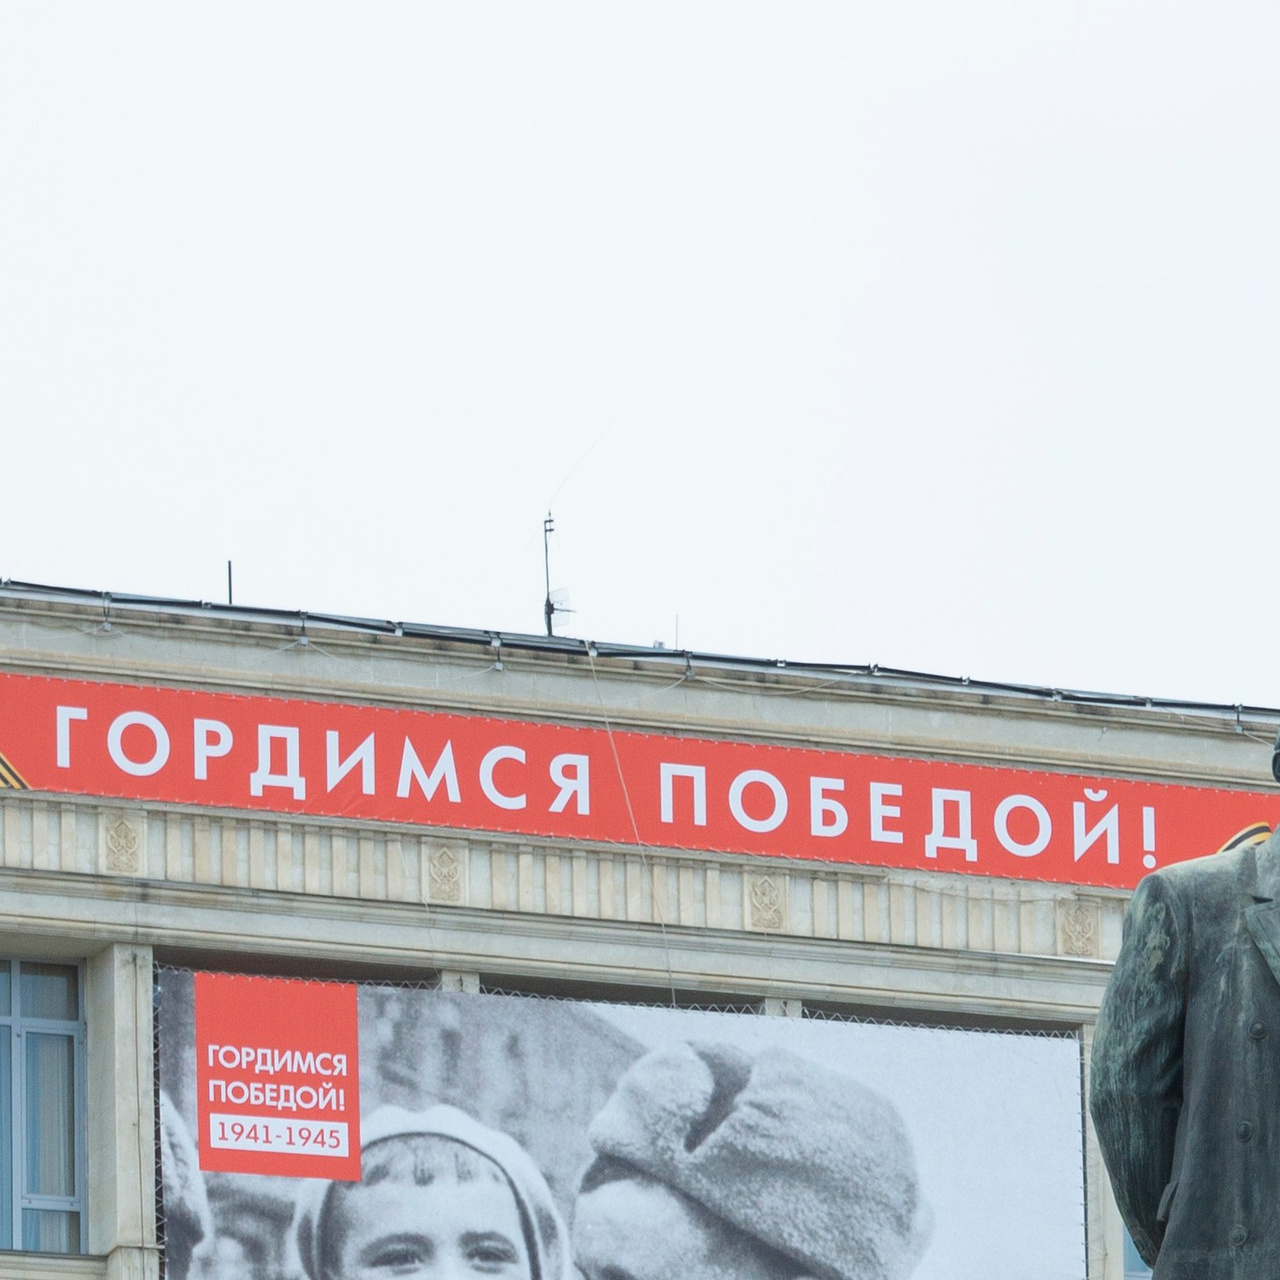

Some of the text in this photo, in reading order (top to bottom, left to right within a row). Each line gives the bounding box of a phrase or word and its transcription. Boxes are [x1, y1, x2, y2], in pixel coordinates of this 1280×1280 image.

[56, 705, 1157, 869] ГОРДИМСЯ ПОБЕДОЙ!
[207, 1044, 347, 1077] ГОРДИМСЯ
[208, 1079, 346, 1112] ПОБЕДОЙ!
[217, 1121, 341, 1149] 1941-1945
